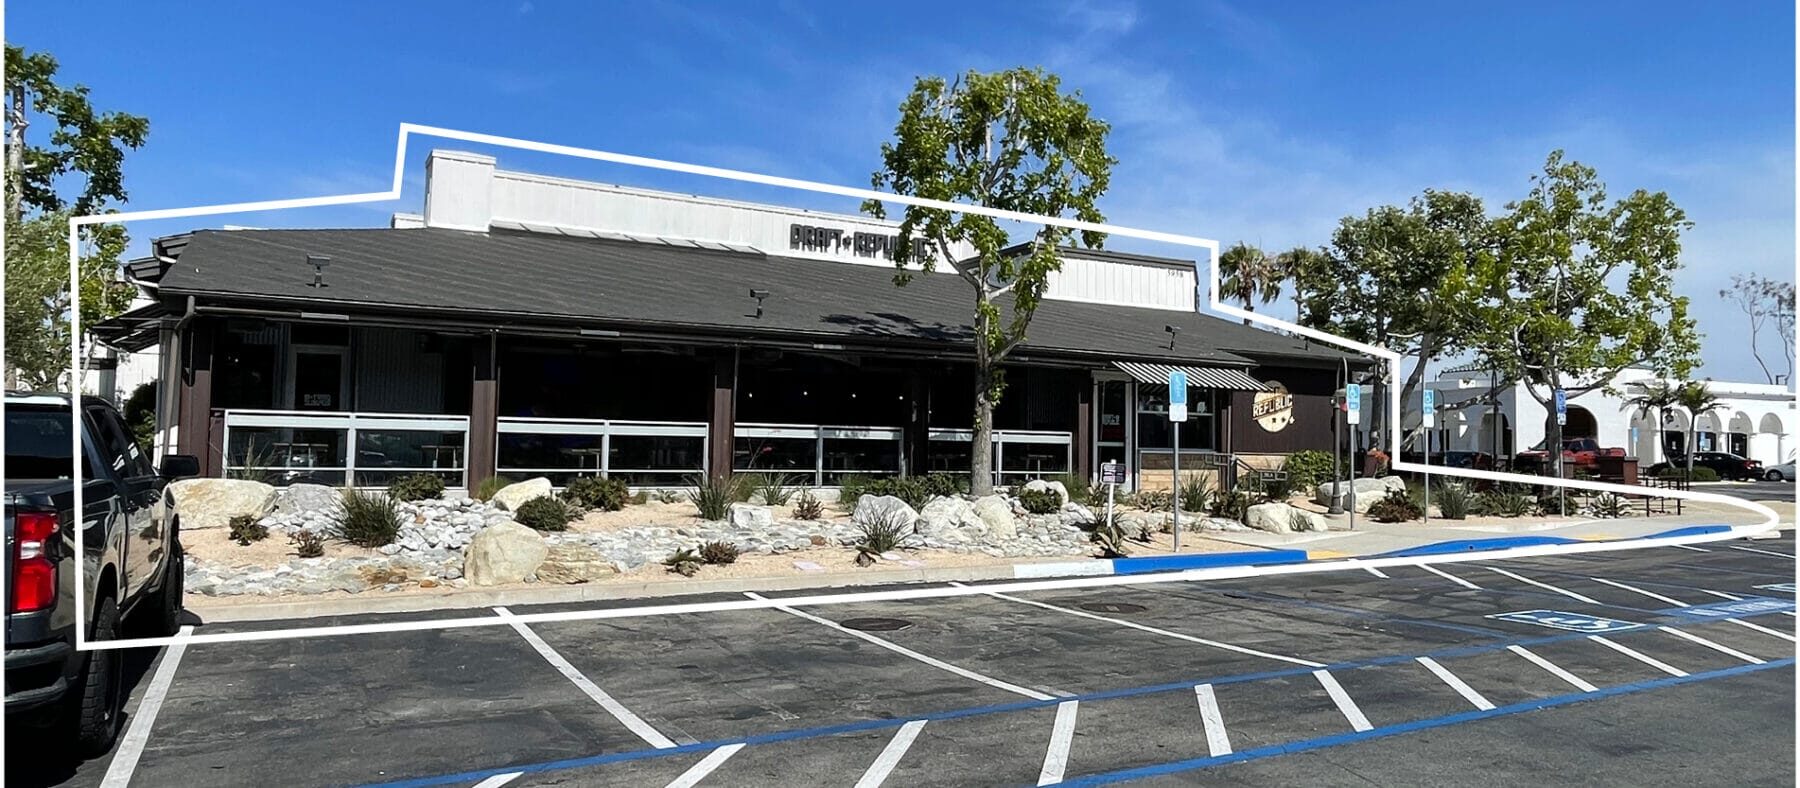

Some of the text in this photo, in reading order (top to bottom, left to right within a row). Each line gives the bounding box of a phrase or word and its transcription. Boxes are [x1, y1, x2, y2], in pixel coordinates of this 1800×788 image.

[790, 223, 929, 261] DRAFT REPUIC
[1252, 394, 1293, 417] REPUBLIC
